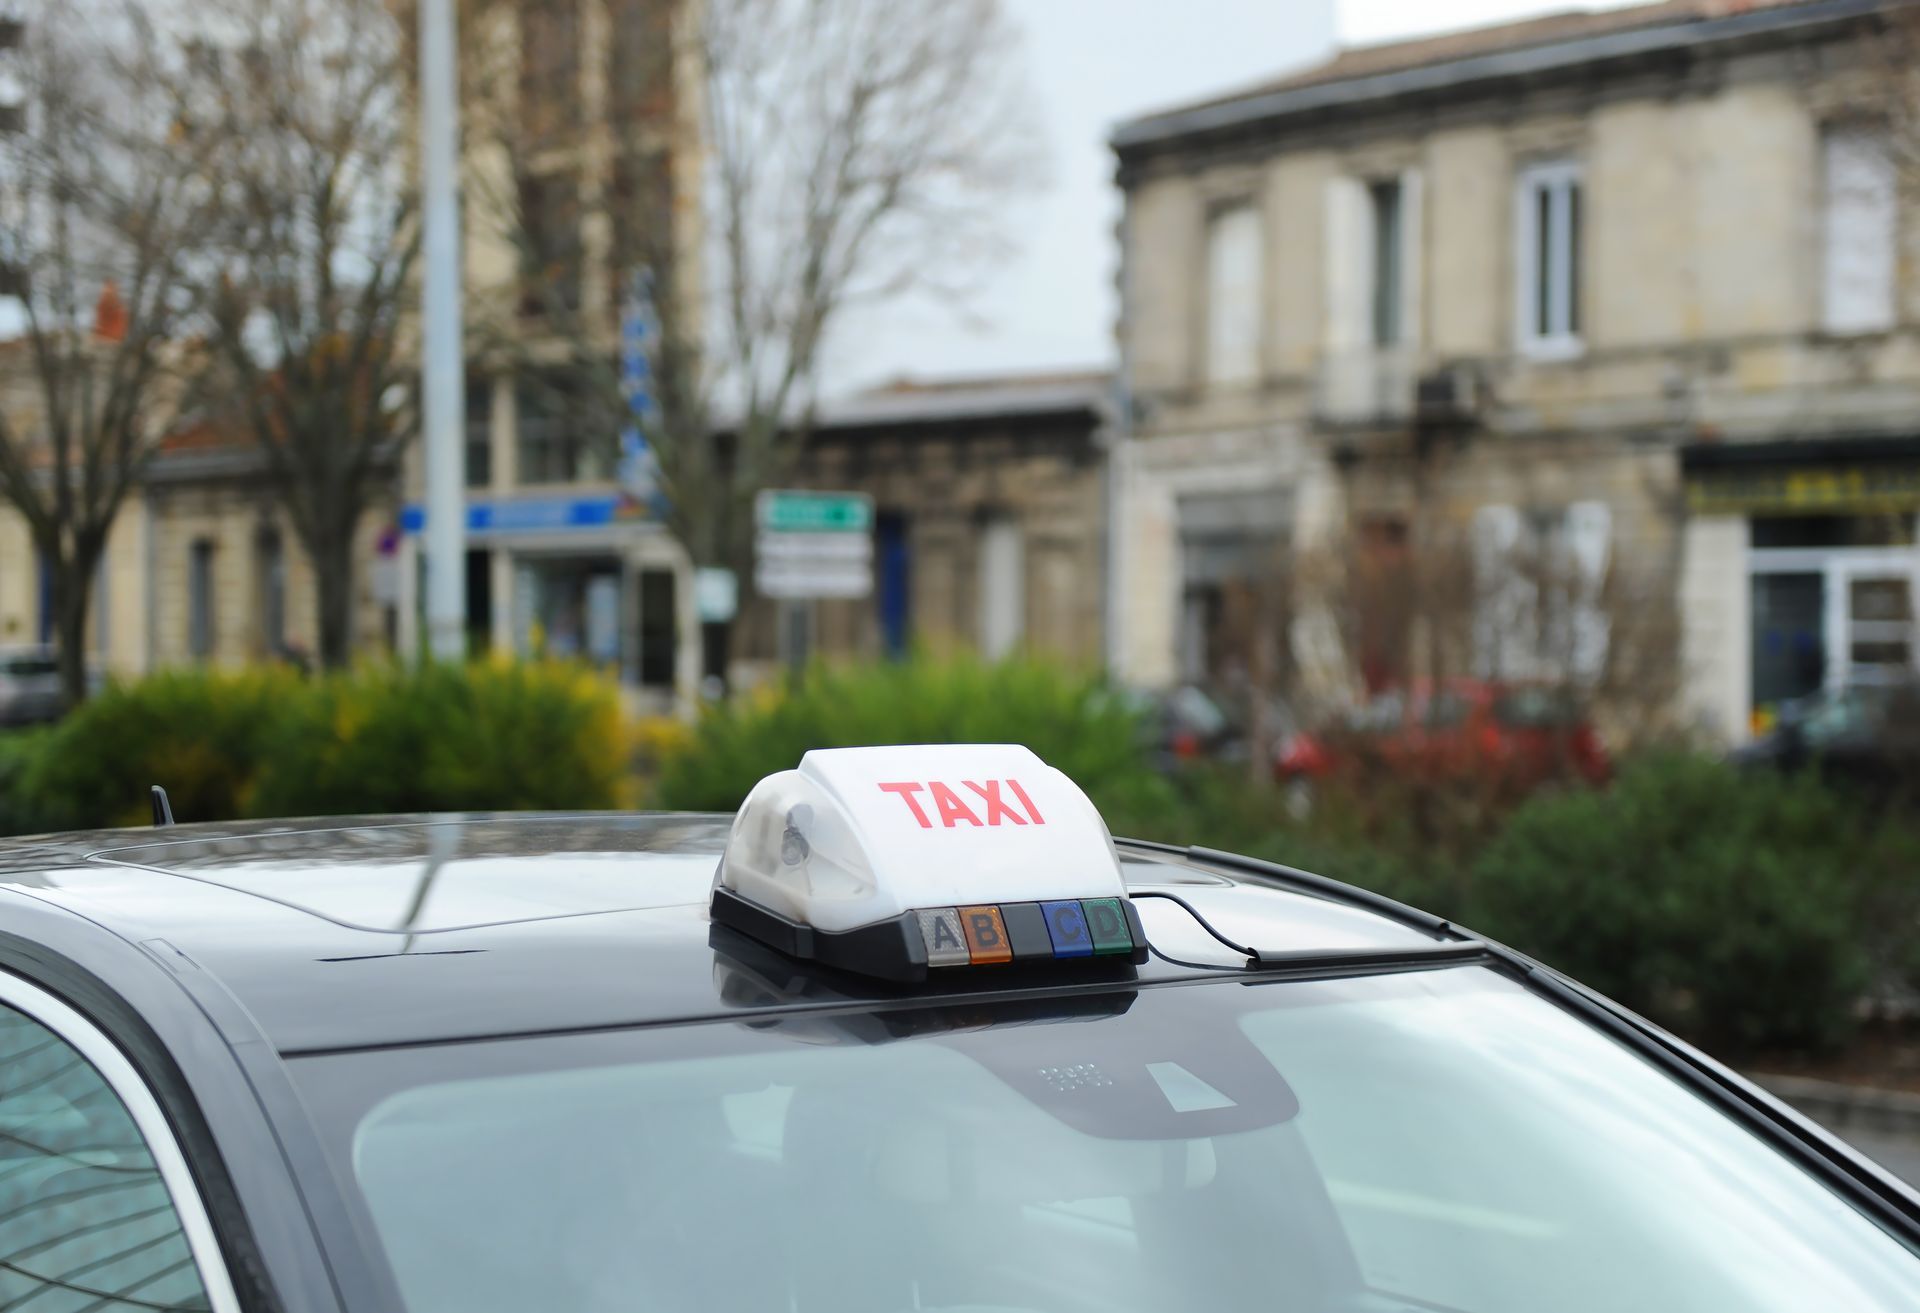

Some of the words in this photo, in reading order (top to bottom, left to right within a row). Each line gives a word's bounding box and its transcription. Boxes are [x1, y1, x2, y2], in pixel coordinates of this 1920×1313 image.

[878, 779, 1045, 828] TAXI
[933, 916, 960, 950] A
[972, 913, 999, 946] B
[1054, 908, 1082, 941] C
[1093, 905, 1120, 937] D
